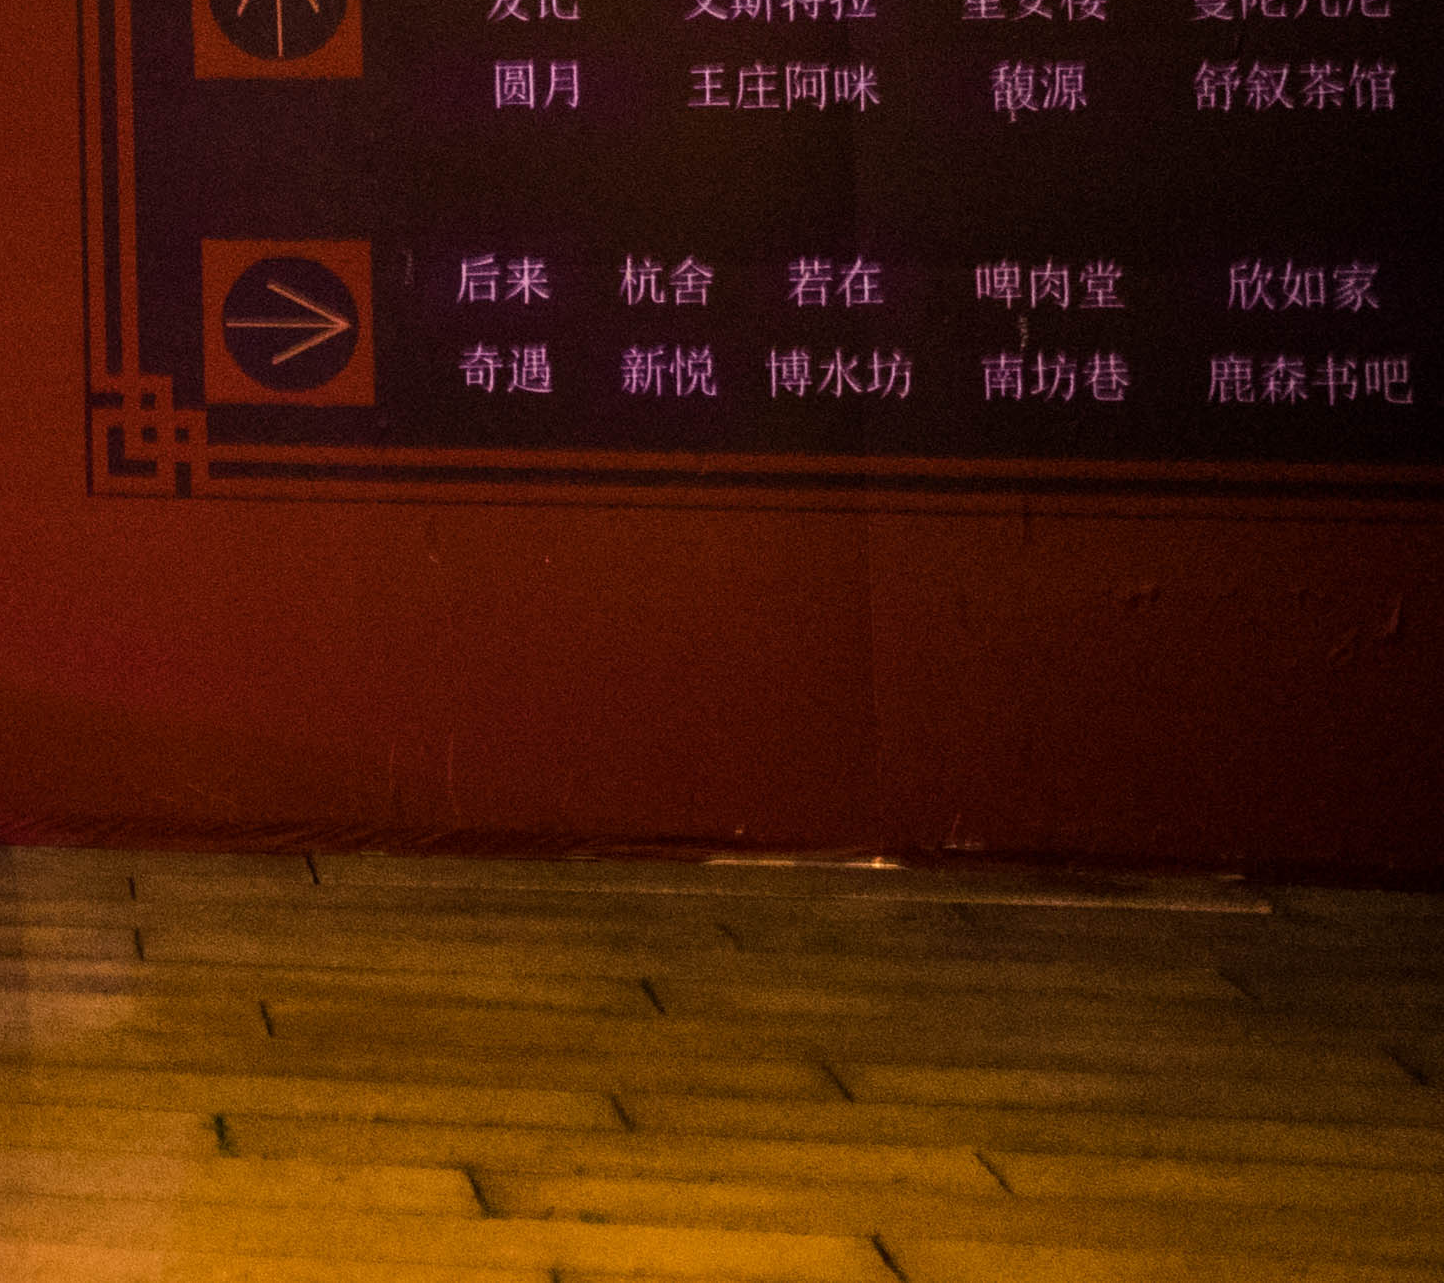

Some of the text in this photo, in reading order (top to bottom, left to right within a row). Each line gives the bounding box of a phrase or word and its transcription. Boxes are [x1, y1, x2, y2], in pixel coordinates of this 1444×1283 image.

[495, 61, 579, 109] 圆月
[689, 62, 879, 111] 王庄阿咪
[1195, 61, 1395, 112] 舒叙茶馆
[458, 255, 1378, 311] 后来 杭舍 若在 啤肉堂 欣如家
[460, 344, 1412, 405] 奇遇 新悦 博水坊 南坊巷 鹿森书吧
